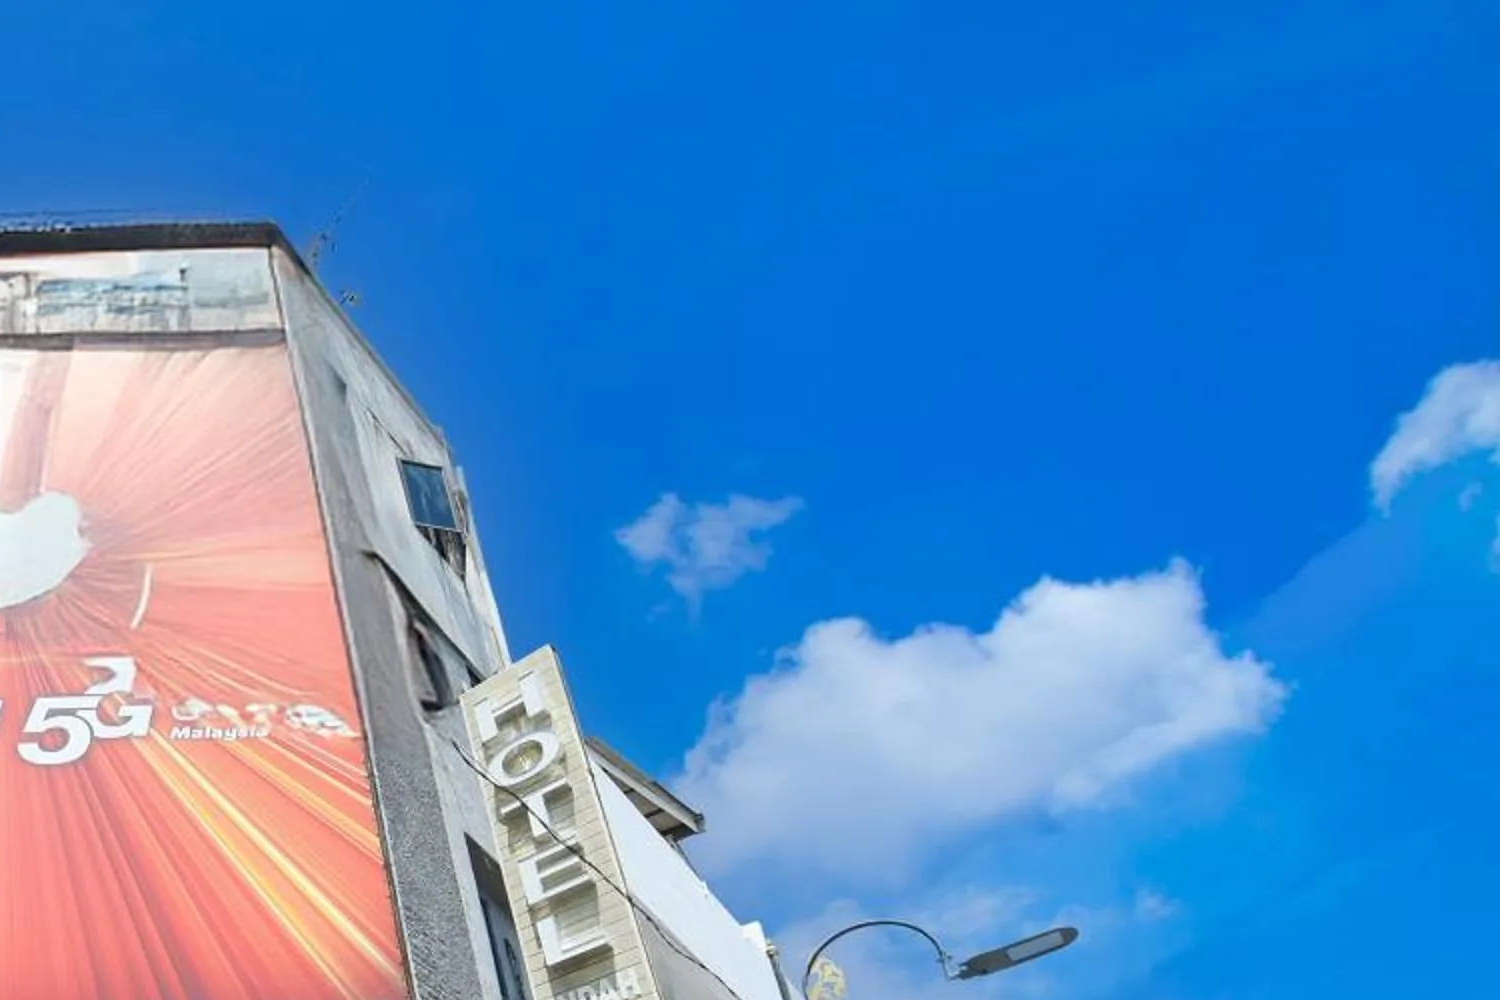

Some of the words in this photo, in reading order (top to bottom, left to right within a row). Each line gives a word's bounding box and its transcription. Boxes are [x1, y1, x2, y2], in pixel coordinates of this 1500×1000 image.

[18, 695, 152, 766] 5G
[169, 727, 270, 741] Malaysia
[474, 671, 613, 967] HOTEL
